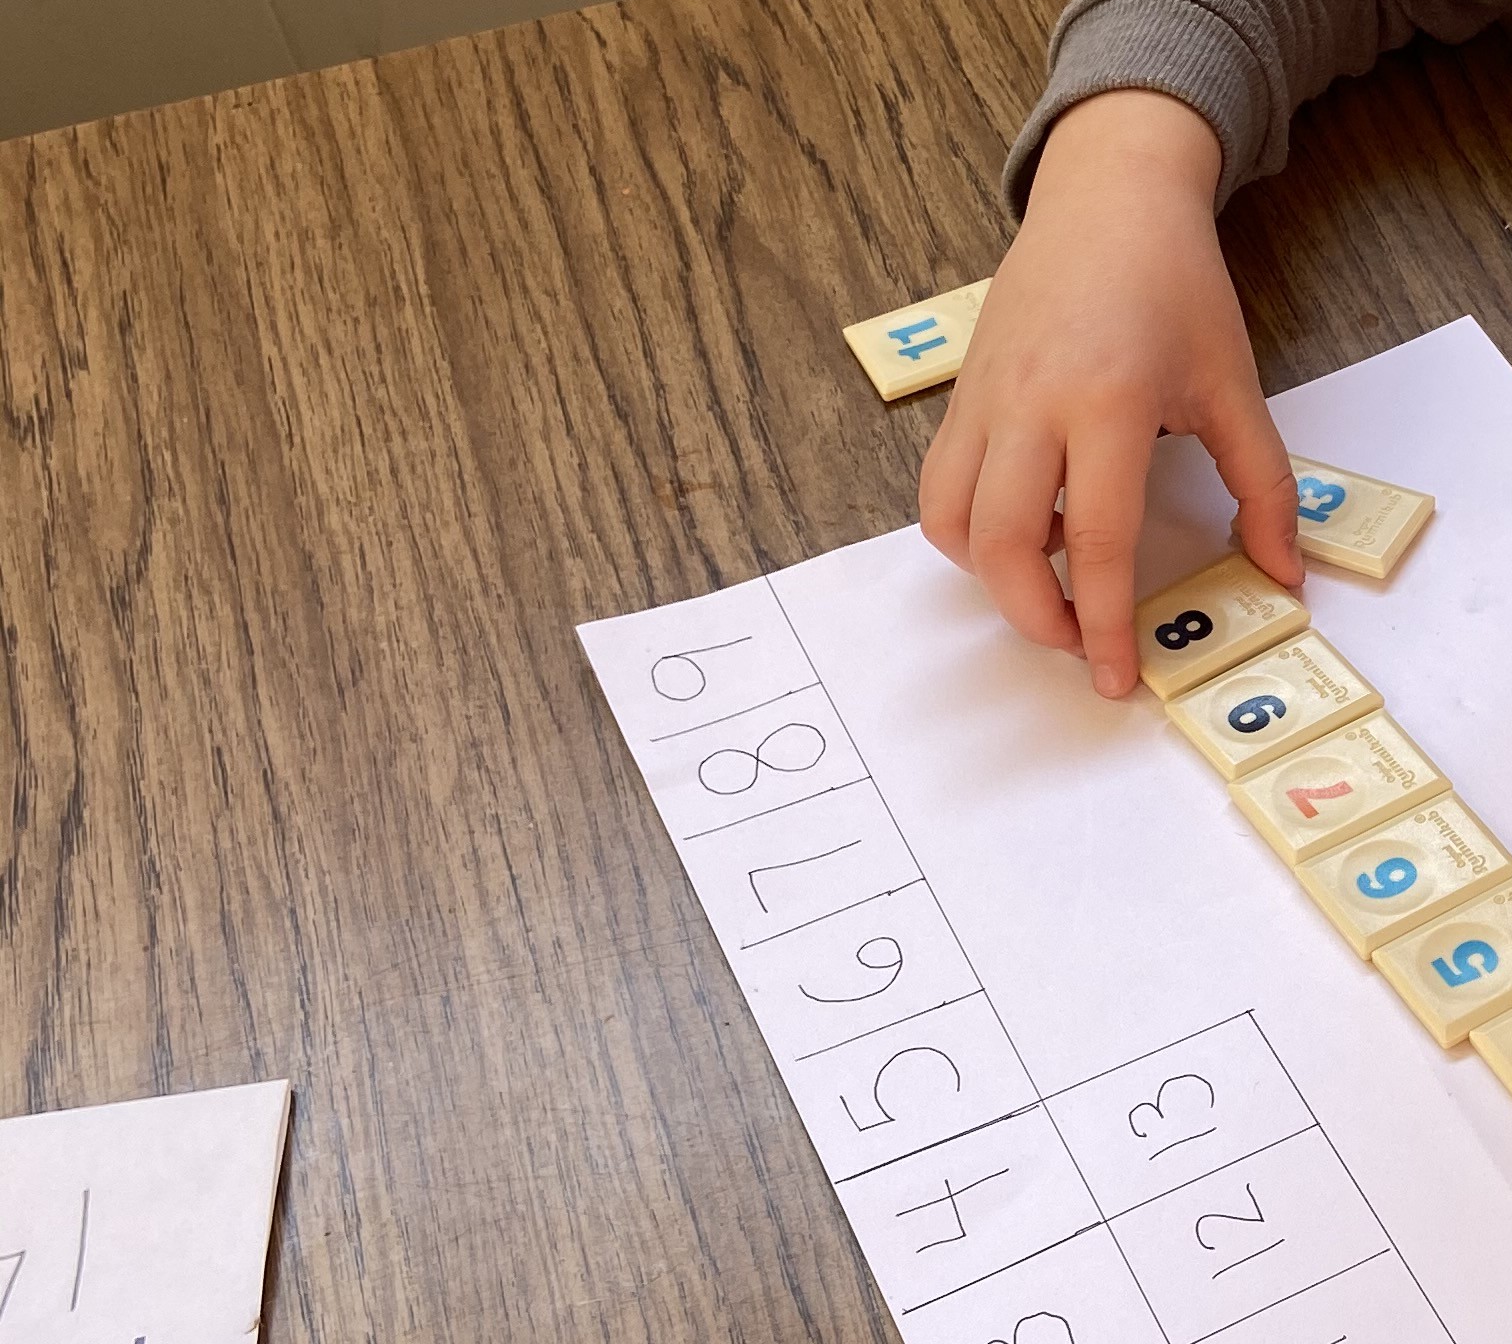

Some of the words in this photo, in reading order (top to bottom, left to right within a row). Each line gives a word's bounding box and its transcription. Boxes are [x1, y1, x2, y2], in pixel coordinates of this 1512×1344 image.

[888, 317, 947, 362] 11
[1297, 476, 1347, 523] 13
[1155, 610, 1213, 650] 8
[651, 635, 753, 701] 9
[698, 723, 827, 795] 8
[1285, 780, 1354, 820] 7
[748, 840, 862, 913] 7
[798, 936, 903, 1003] 6
[1431, 939, 1499, 988] 5
[840, 1047, 960, 1132] 5
[1128, 1073, 1217, 1161] 13
[896, 1168, 1009, 1254] 4
[1196, 1182, 1286, 1280] 12
